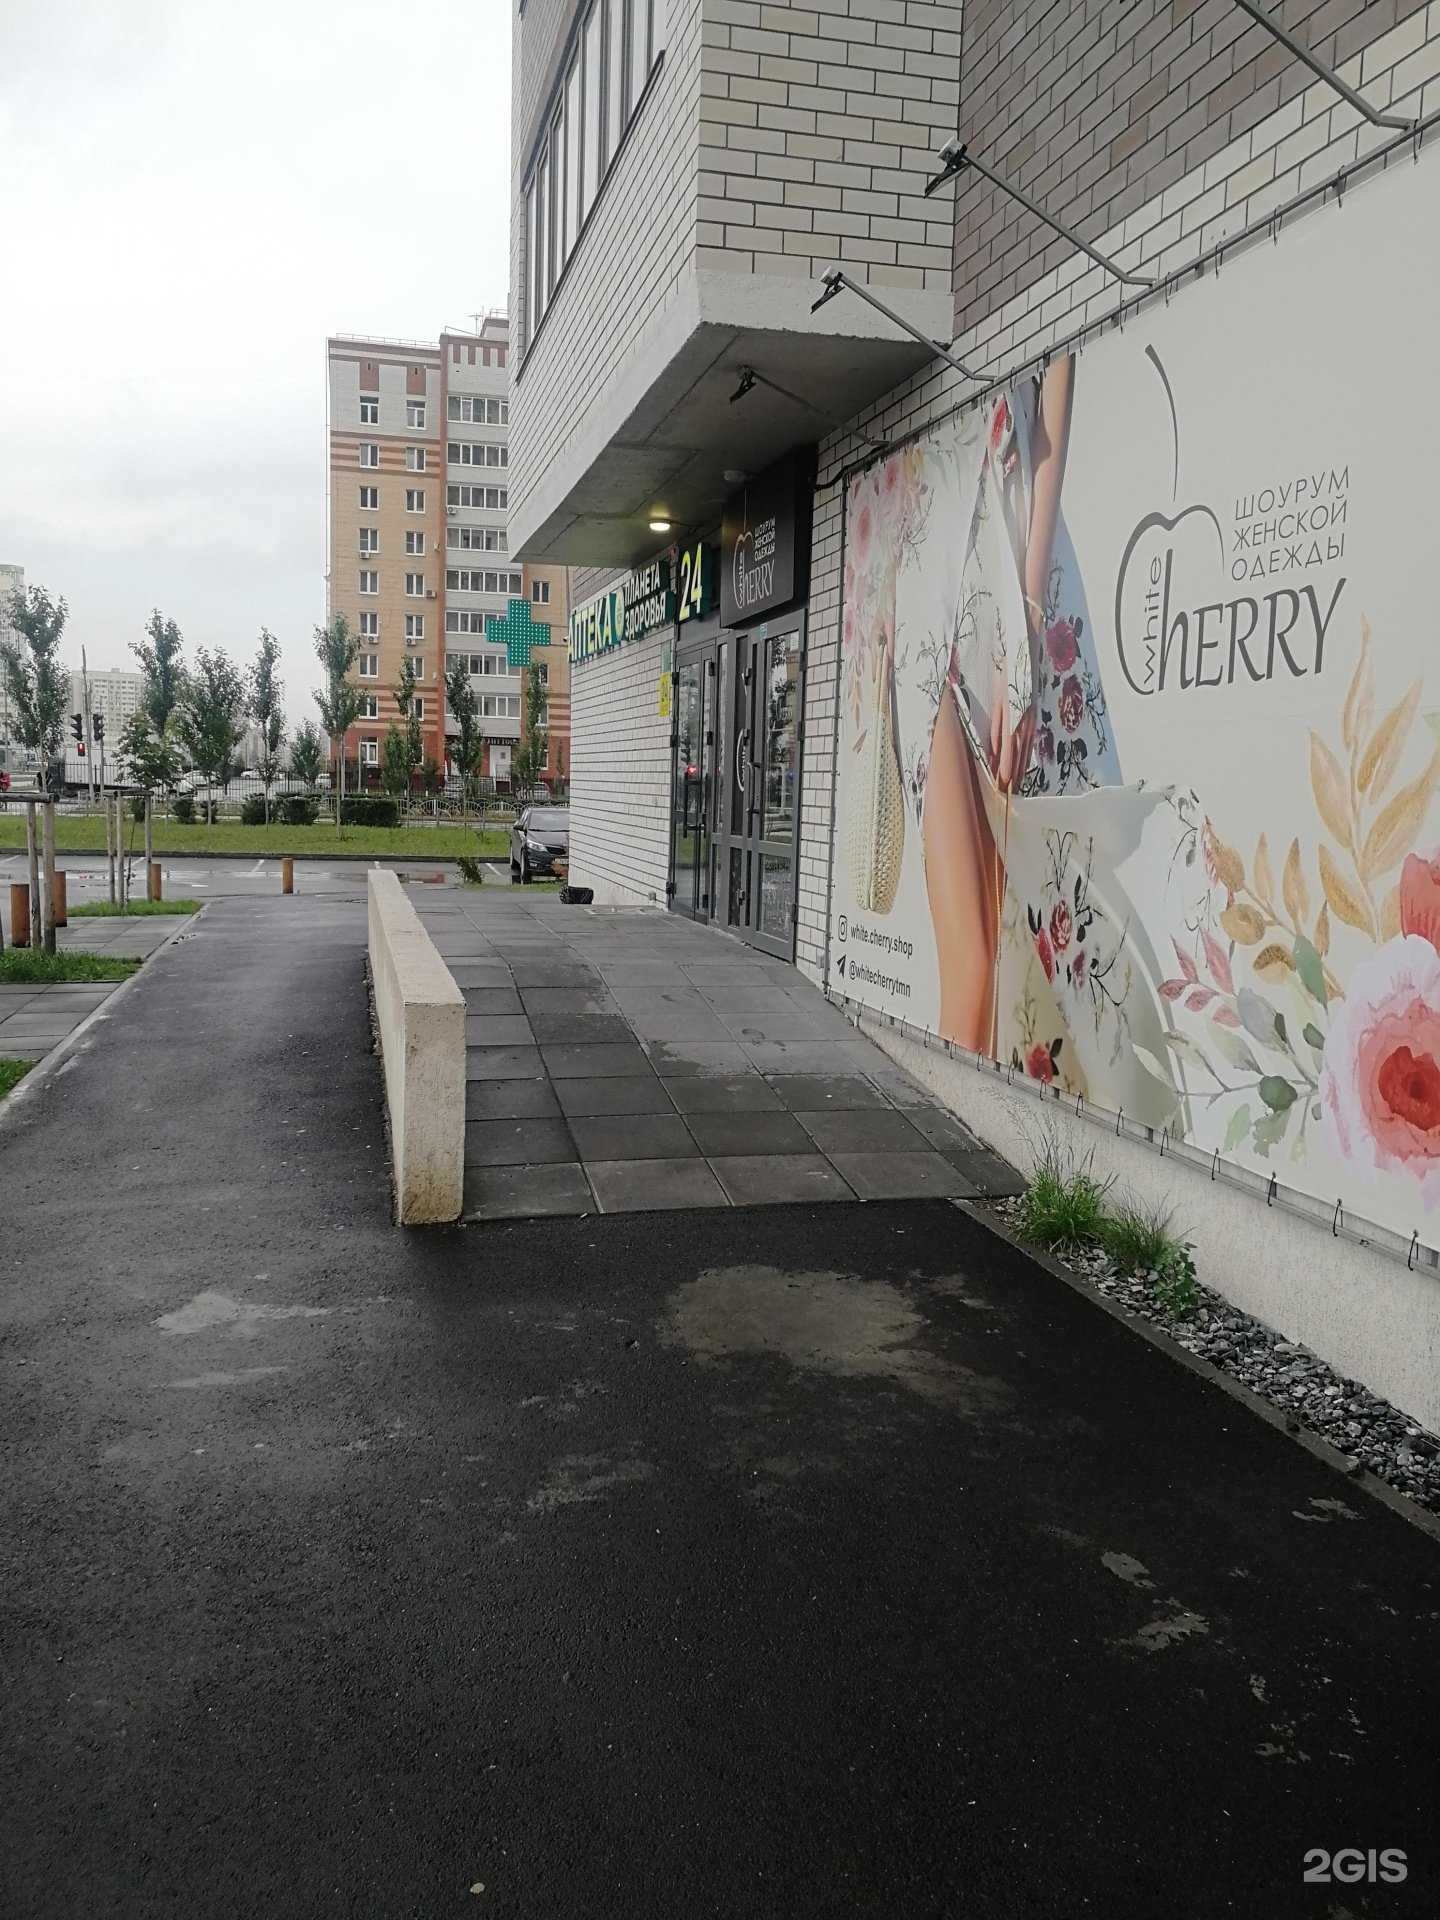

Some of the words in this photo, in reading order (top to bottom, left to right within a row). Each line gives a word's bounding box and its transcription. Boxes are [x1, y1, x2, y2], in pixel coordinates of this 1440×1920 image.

[1235, 465, 1349, 521] ШОУРУМ
[1233, 494, 1348, 552] ЖЕНСКОЙ
[679, 542, 703, 621] 24
[1231, 533, 1345, 581] ОДЕЖДЫ
[622, 561, 660, 607] ПЛАНЕТА
[567, 592, 612, 663] АПТЕКА
[624, 591, 666, 640] ЗДОРОВЬЯ
[1143, 556, 1161, 685] white
[850, 924, 913, 959] white.cherry.shop
[849, 960, 911, 997] @whitecherrytmn
